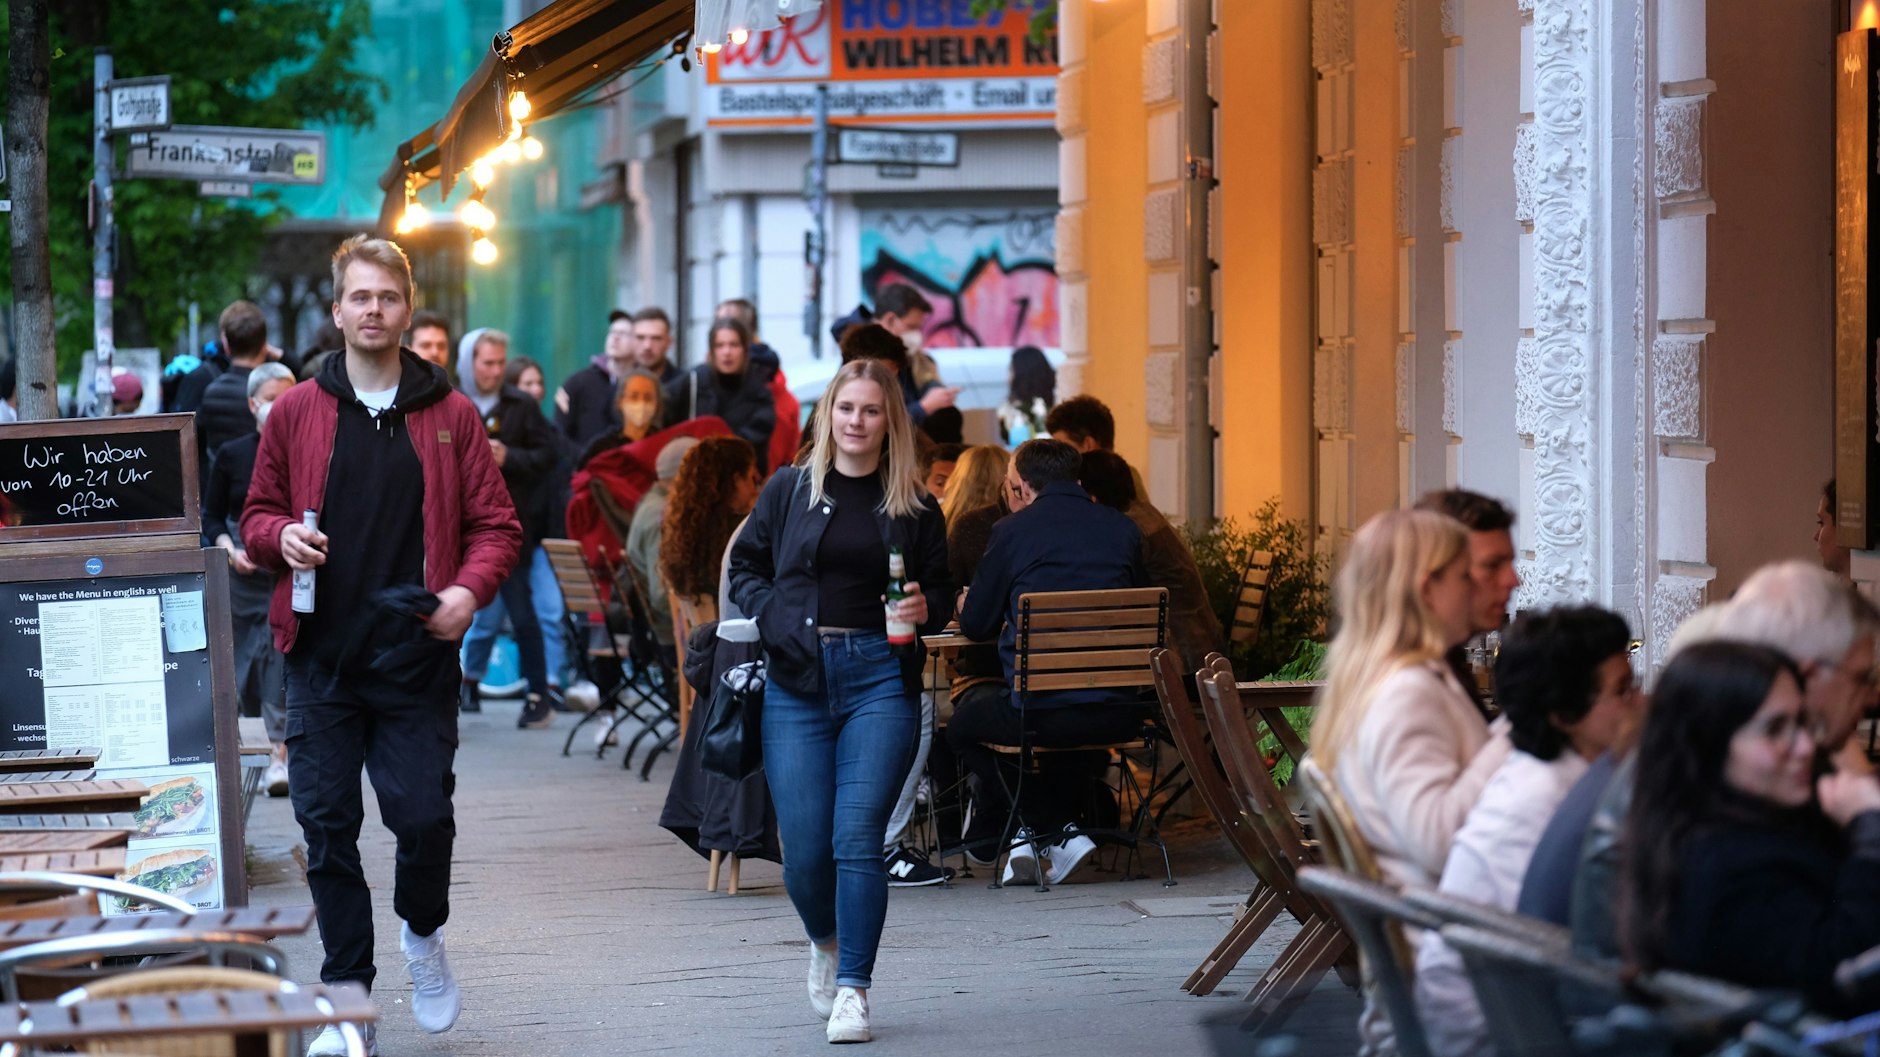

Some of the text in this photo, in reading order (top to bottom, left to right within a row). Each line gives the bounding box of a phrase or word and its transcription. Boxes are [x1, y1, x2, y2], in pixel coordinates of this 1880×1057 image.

[843, 36, 1010, 69] WILHELM
[973, 80, 1028, 105] Email
[24, 441, 147, 469] Wir haben
[0, 467, 153, 493] von 10-21 Uhr
[57, 491, 119, 518] offen
[19, 593, 35, 602] We
[35, 592, 58, 601] have
[58, 591, 74, 600] the
[75, 590, 101, 598] Menu
[102, 589, 112, 597] in
[112, 586, 145, 598] english
[157, 585, 177, 594] well
[163, 662, 178, 673] pe
[17, 734, 47, 742] wechse
[171, 756, 200, 764] schwarze
